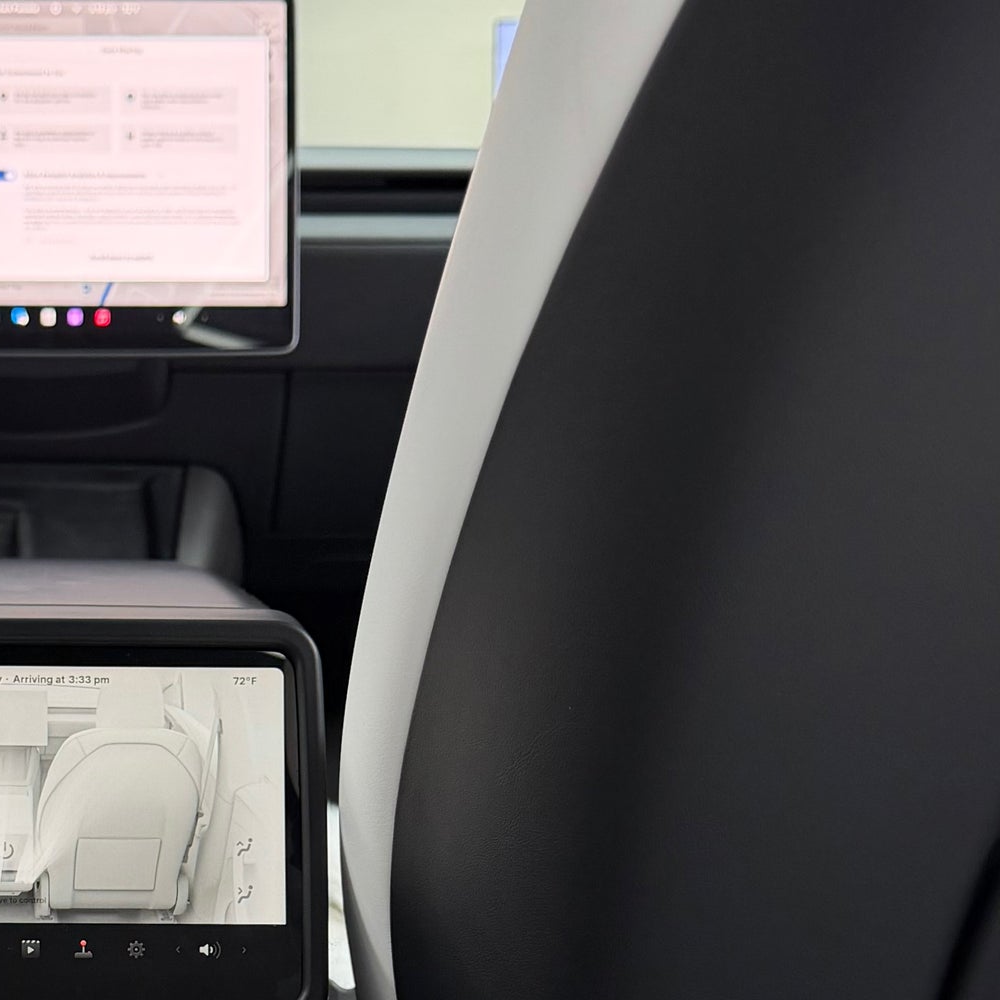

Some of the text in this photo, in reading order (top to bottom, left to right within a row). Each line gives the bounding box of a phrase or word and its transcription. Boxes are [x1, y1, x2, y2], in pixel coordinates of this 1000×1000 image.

[13, 674, 53, 685] Arriving
[55, 675, 65, 684] at
[68, 675, 91, 684] 3:33
[93, 677, 110, 686] pm
[233, 676, 257, 686] 72°F
[9, 896, 18, 904] to
[18, 896, 47, 904] control
